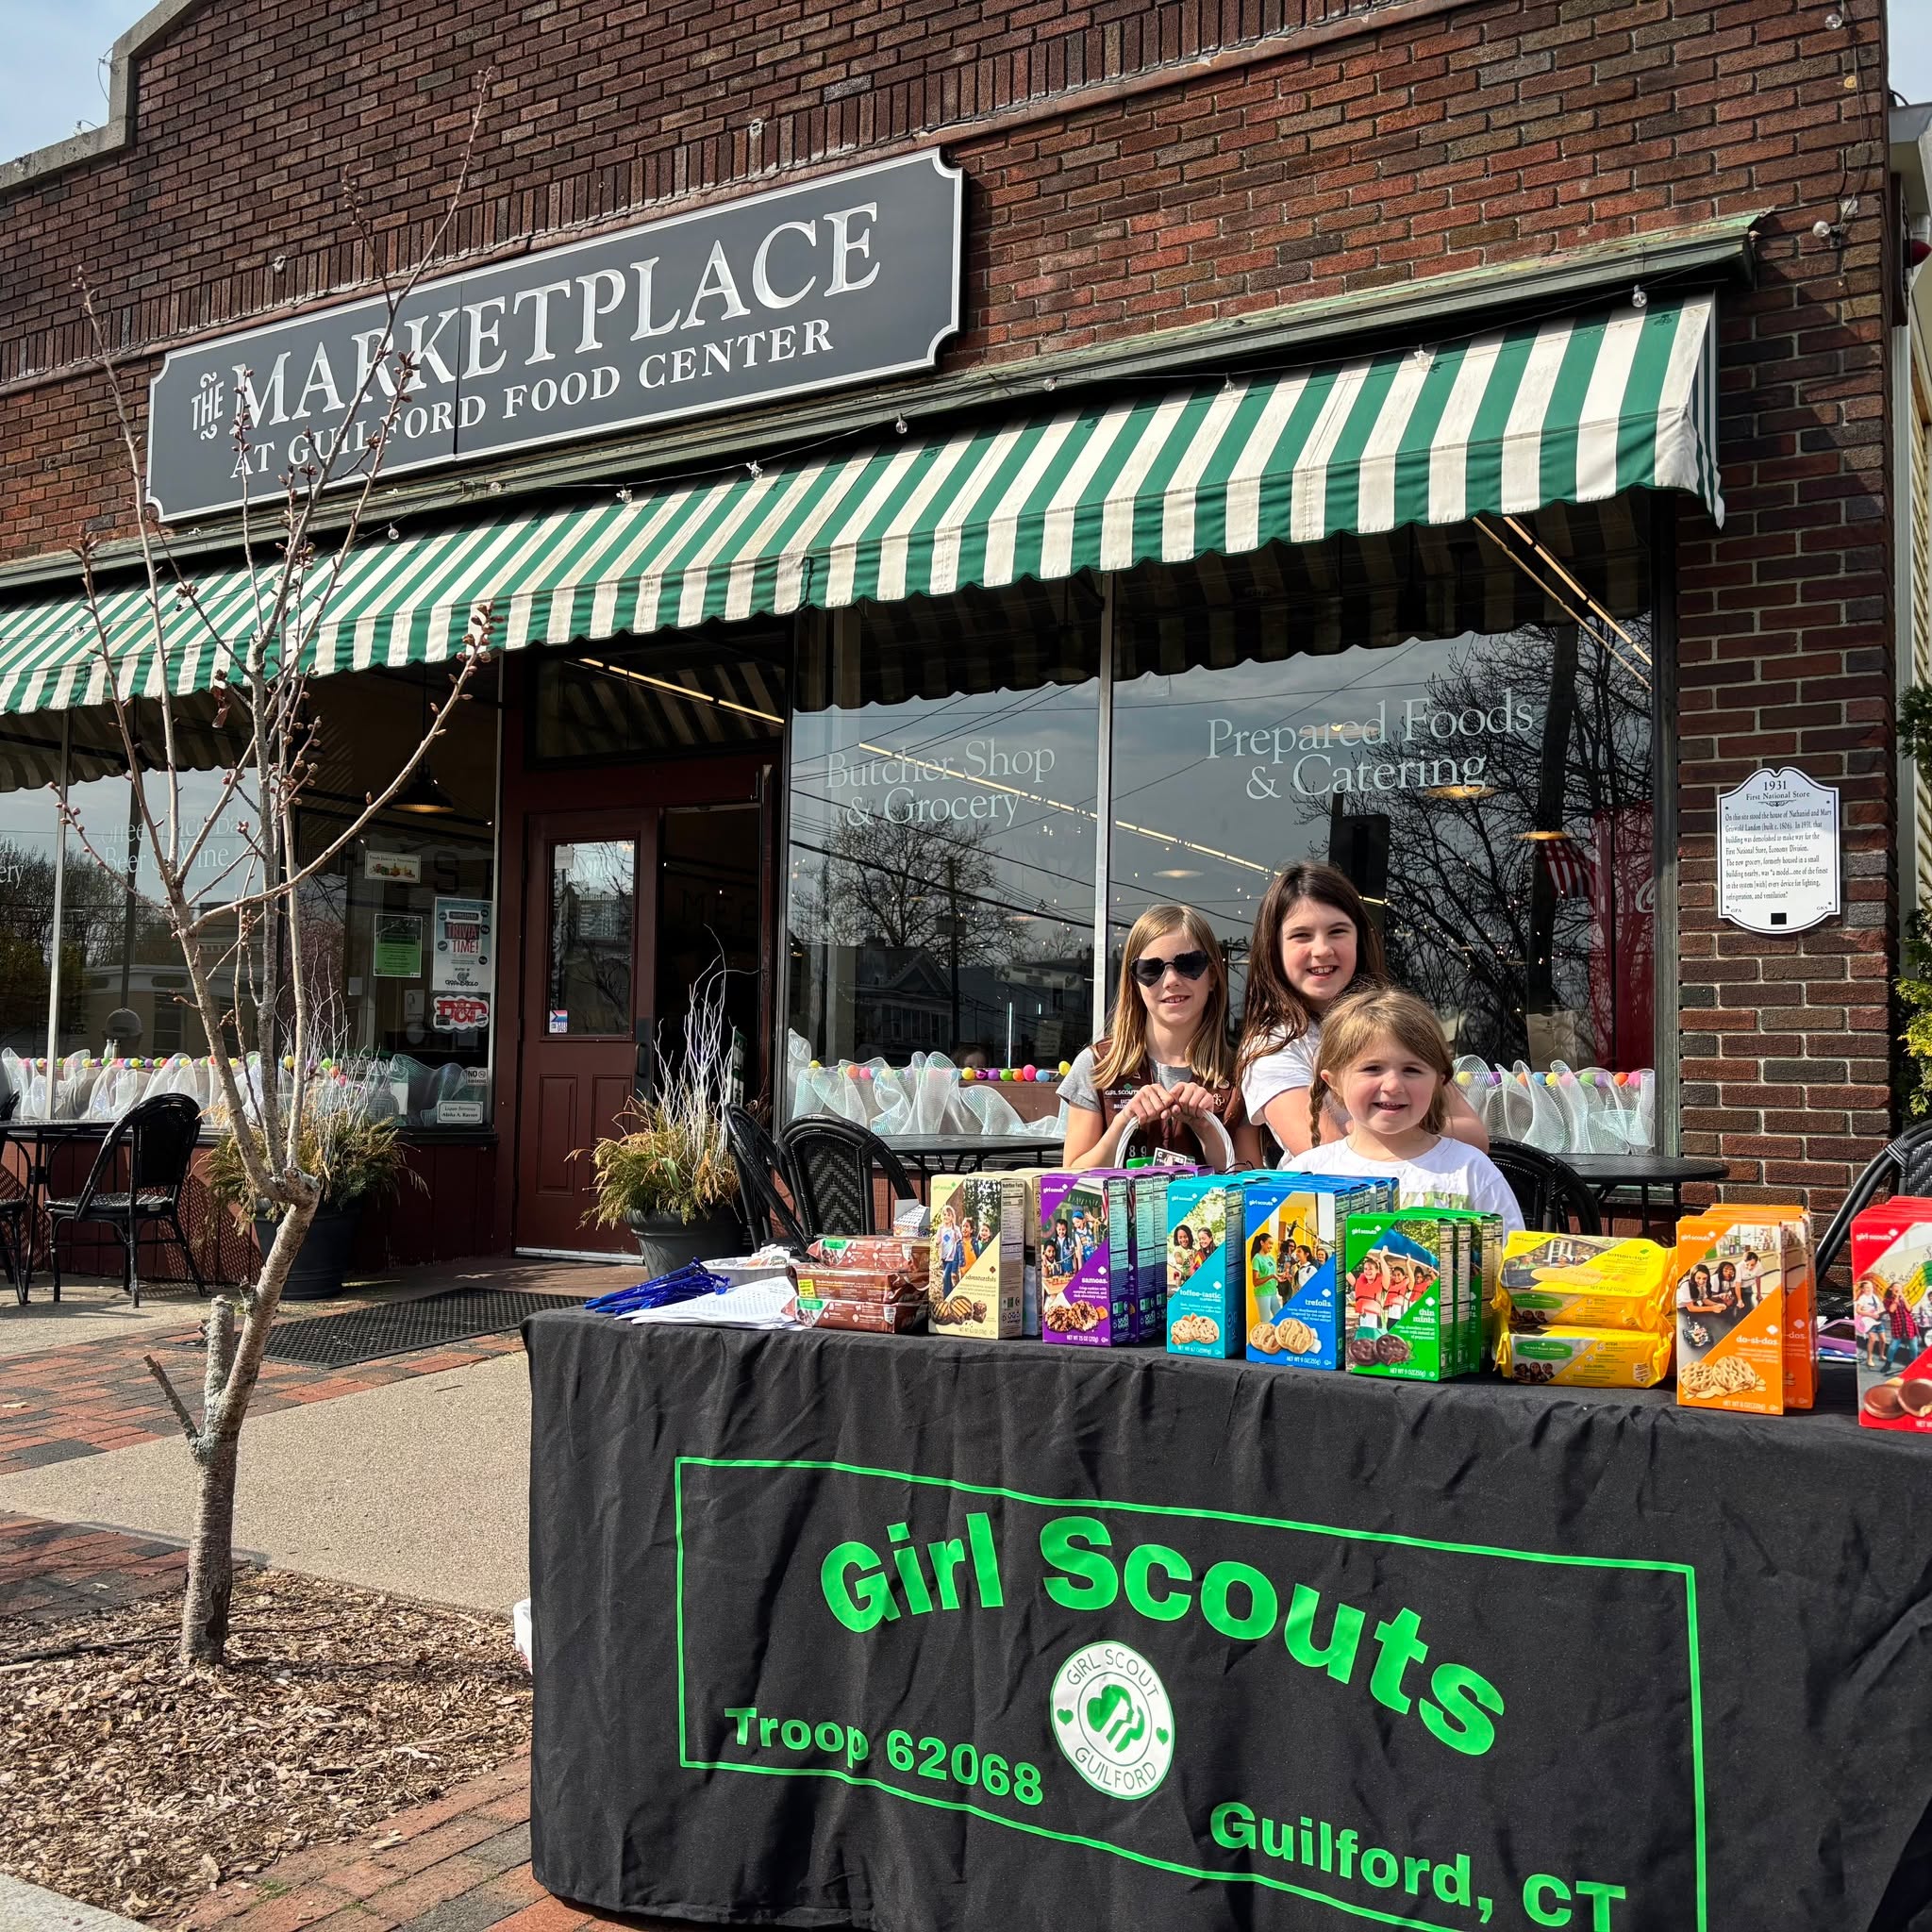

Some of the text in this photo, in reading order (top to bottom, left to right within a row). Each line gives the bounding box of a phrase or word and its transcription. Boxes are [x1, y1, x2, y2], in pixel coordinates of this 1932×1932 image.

[192, 201, 880, 435] THE MARKETPLACE
[230, 441, 275, 478] AT
[503, 366, 621, 420] FOOD
[640, 319, 834, 389] CENTER
[1207, 687, 1533, 764] Prepared Foods
[824, 738, 1056, 789] Butcher Shop
[1246, 749, 1488, 799] & Catering
[1763, 792, 1790, 800] National
[1764, 781, 1787, 791] 1931
[846, 787, 1022, 827] & Grocery
[1749, 812, 1761, 820] stood
[104, 846, 147, 874] Beer
[1726, 869, 1743, 878] building
[447, 924, 477, 939] TRIVIA
[452, 940, 478, 953] TIME!
[1180, 1289, 1221, 1299] toffee-tastic
[1305, 1299, 1331, 1307] trefoils
[1419, 1308, 1435, 1316] thin
[1736, 1335, 1778, 1345] do-si-dos
[822, 1512, 1505, 1756] Girl Scouts
[1066, 1649, 1159, 1697] GIRL SCOUT
[724, 1707, 1043, 1806] Troop 62068
[1075, 1747, 1156, 1790] GUILFORD
[1211, 1802, 1627, 1932] Guilford, CT
